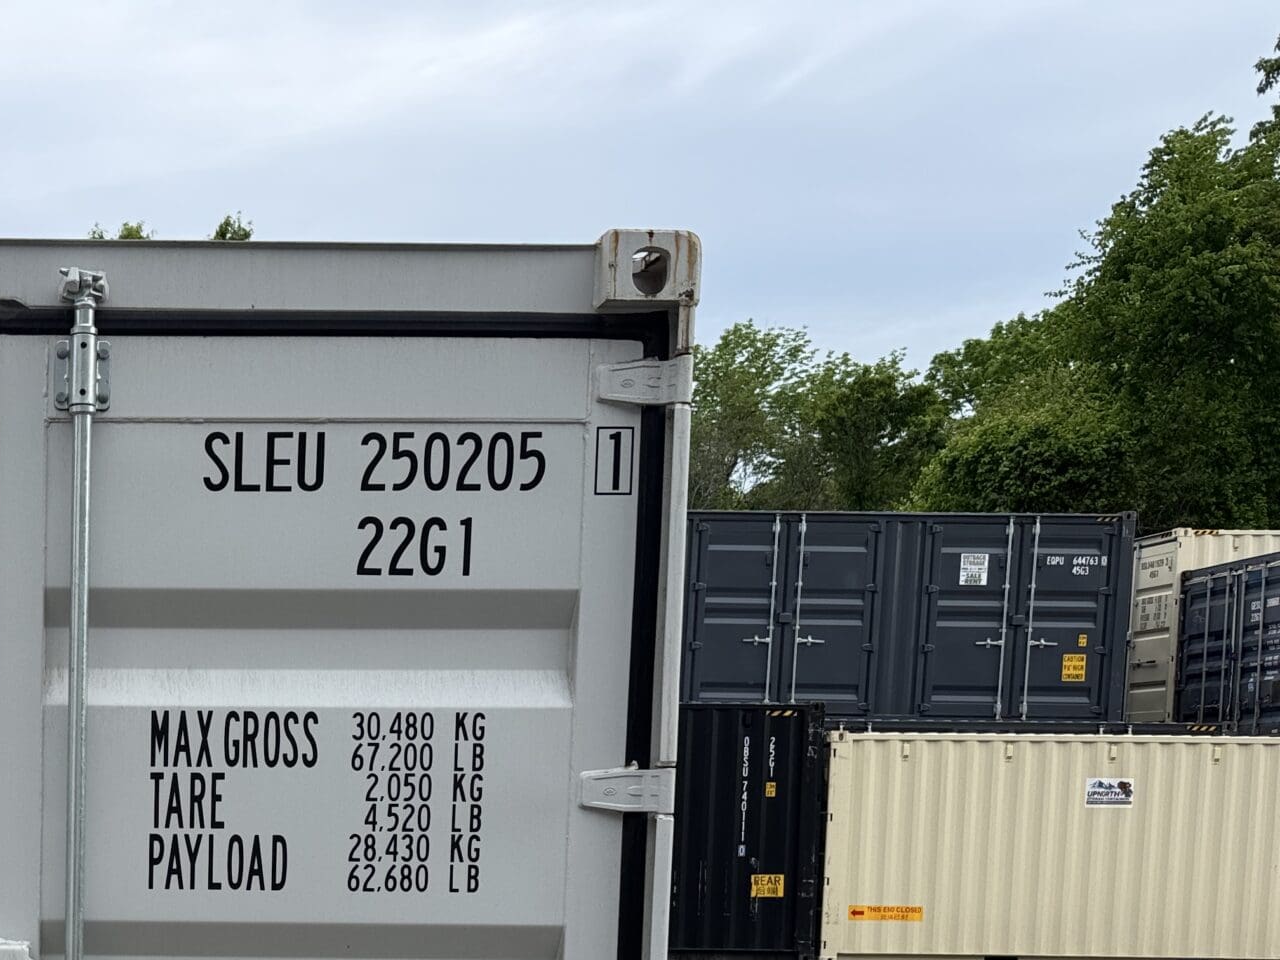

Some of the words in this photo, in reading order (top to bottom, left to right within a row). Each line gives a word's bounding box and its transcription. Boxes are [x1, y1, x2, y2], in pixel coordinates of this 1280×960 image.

[202, 431, 326, 493] SLEU
[360, 431, 546, 492] 250205
[608, 431, 622, 491] 1
[356, 516, 473, 577] 22G1
[1047, 556, 1064, 565] EQPU
[1072, 556, 1098, 566] 644763
[1072, 567, 1089, 575] 45G3
[150, 710, 214, 768] MAX
[223, 710, 319, 769] GROSS
[351, 711, 434, 741] 30,480
[454, 711, 486, 741] KG
[351, 742, 433, 772] 67,200
[453, 742, 485, 772] LB
[149, 772, 226, 830] TARE
[365, 772, 432, 802] 2,050
[452, 773, 484, 802] KG
[364, 803, 431, 832] 4,520
[451, 803, 482, 832] LB
[147, 833, 288, 891] PAYLOAD
[348, 833, 430, 862] 28,430
[450, 834, 481, 862] KG
[347, 864, 429, 893] 62,680
[448, 864, 480, 893] LB
[753, 875, 781, 886] REAR
